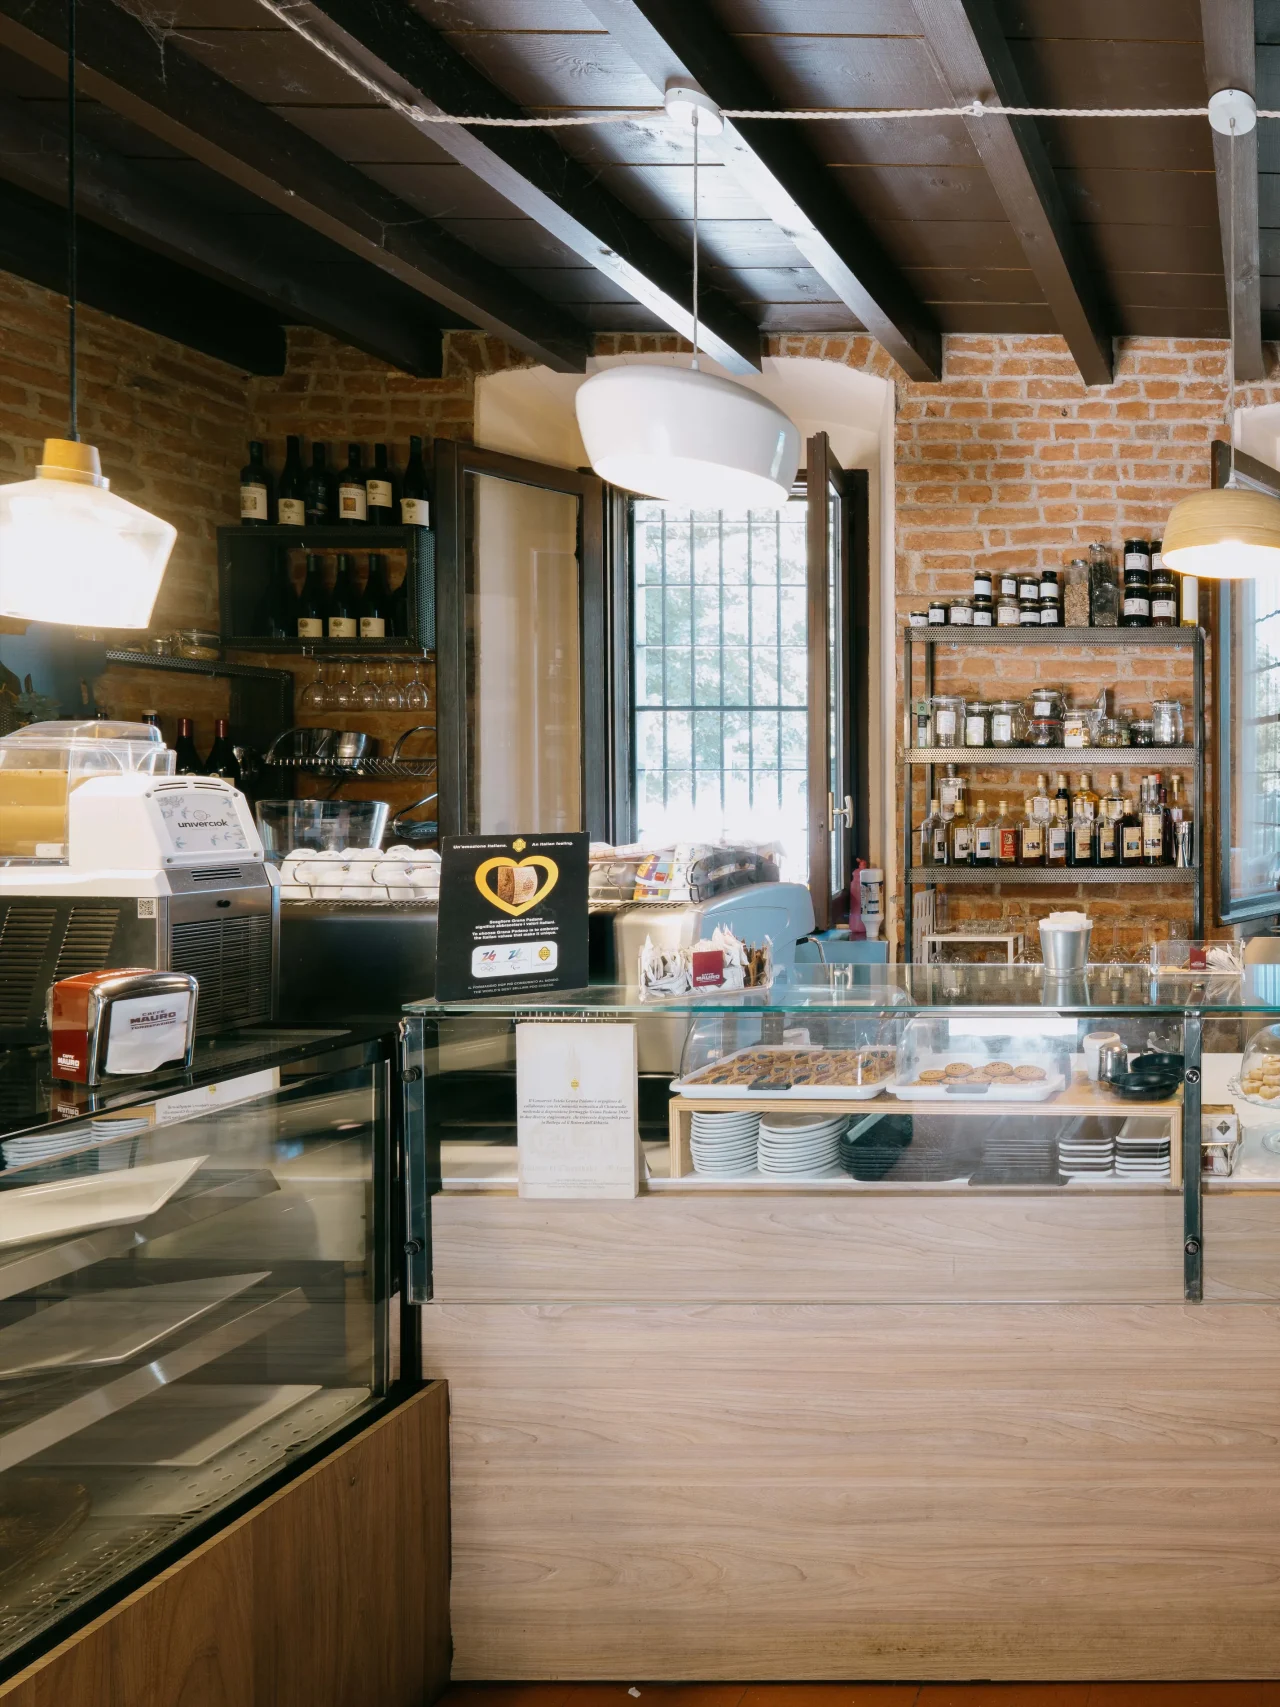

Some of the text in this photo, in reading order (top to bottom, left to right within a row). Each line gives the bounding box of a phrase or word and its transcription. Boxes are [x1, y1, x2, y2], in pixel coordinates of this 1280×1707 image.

[177, 819, 229, 828] univerciok
[696, 974, 720, 982] MAURO
[129, 1011, 177, 1025] MAURO
[57, 1056, 80, 1068] MAURO
